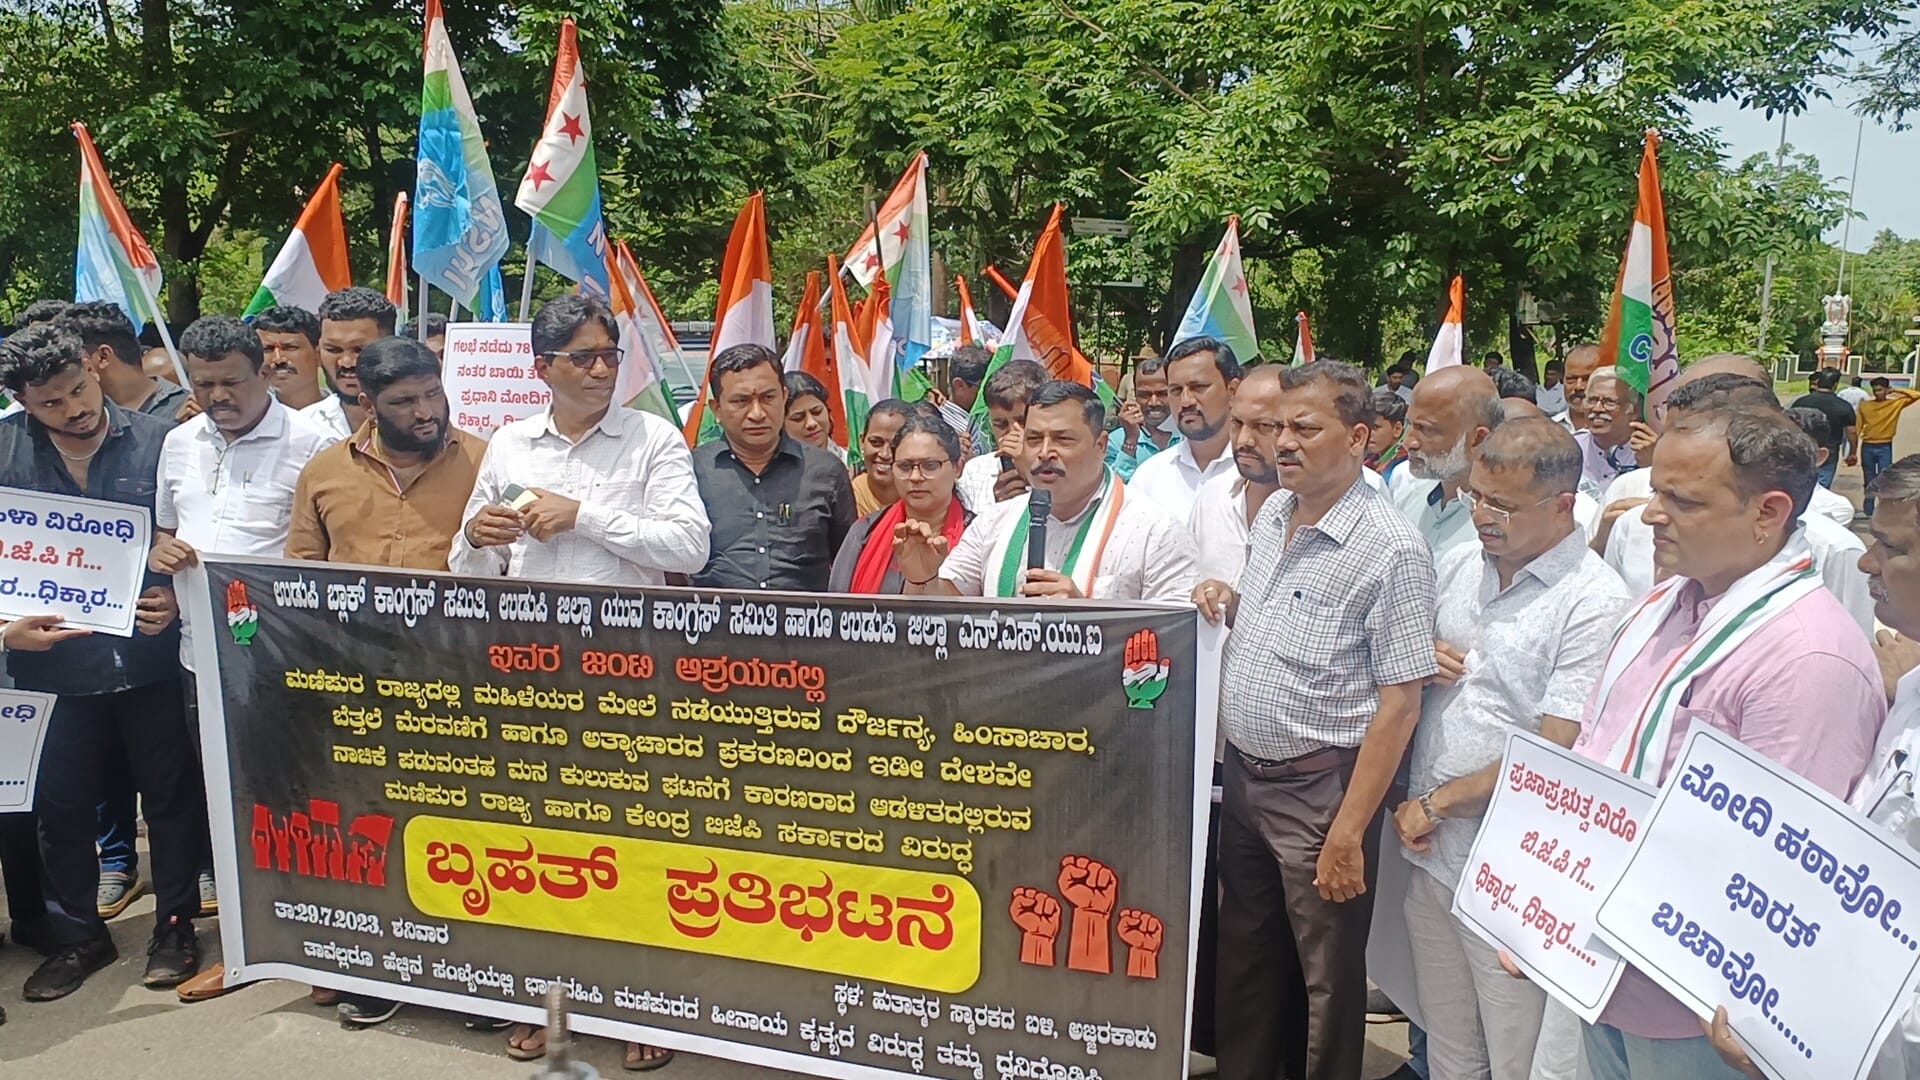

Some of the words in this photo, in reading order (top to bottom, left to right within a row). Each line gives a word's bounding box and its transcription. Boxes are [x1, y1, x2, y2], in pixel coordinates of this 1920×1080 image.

[453, 338, 477, 355] ಗಲಭೆ
[479, 339, 513, 354] ನಡೆದು
[516, 343, 531, 353] 78
[457, 364, 487, 377] ನಂತರ
[489, 367, 524, 379] ಬಾಯಿ
[461, 389, 497, 405] ಪ್ರಧಾನಿ
[500, 389, 551, 405] ಮೋದಿಗೆ
[45, 511, 135, 543] ವಿರೋಧಿ
[273, 572, 319, 609] ಉಡುಪಿ
[327, 576, 366, 623] ಬ್ಲಾಕ್
[374, 578, 436, 628] ಕಾಂಗ್ರೆಸ್
[444, 580, 489, 622] ಸಮಿತಿ,
[499, 583, 548, 623] ಉಡುಪಿ
[557, 593, 592, 638] ಜಿಲ್ಲಾ
[601, 591, 644, 628] ಯುವ
[653, 594, 720, 645] ಕಾಂಗ್ರೆಸ್
[729, 596, 777, 636] ಸಮಿತಿ
[785, 600, 833, 639] ಹಾಗೂ
[840, 603, 896, 643] ಉಡುಪಿ
[908, 611, 948, 660] ಜಿಲ್ಲಾ
[488, 642, 560, 673] ಇವರ
[582, 650, 654, 679] ಜಂಟಿ
[675, 653, 826, 703] ಆಶ್ರಯದಲ್ಲಿ
[285, 668, 364, 694] ಮಣಿಪುರ
[376, 678, 461, 710] ರಾಜ್ಯದಲ್ಲಿ
[474, 682, 584, 711] ಮಹಿಳೆಯರ
[598, 690, 657, 717] ಮೇಲೆ
[671, 697, 821, 735] ನಡೆಯುತ್ತಿರುವ
[953, 721, 1096, 756] ಹಿಂಸಾಚಾರ,
[333, 705, 382, 735] ಬೆತ್ತಲೆ
[395, 710, 488, 740] ಮೆರವಣಿಗೆ
[502, 722, 568, 747] ಹಾಗೂ
[582, 728, 704, 763] ಅತ್ಯಾಚಾರದ
[718, 738, 852, 773] ಪ್ರಕರಣದಿಂದ
[868, 754, 924, 779] ಇಡೀ
[940, 756, 1032, 788] ದೇಶವೇ
[333, 744, 387, 767] ನಾಚಿಕೆ
[398, 749, 496, 777] ಪಡುವಂತಹ
[508, 757, 548, 783] ಮನ
[560, 763, 649, 793] ಕುಲುಕುವ
[662, 772, 731, 801] ಘಟನೆಗೆ
[744, 783, 856, 814] ಕಾರಣರಾದ
[870, 795, 1032, 834] ಆಡಳಿತದಲ್ಲಿರುವ
[1510, 762, 1594, 833] ಪ್ರಜಾಪ್ರಭುತ್ವ
[1680, 764, 1773, 837] ಮೋದಿ
[384, 780, 468, 807] ಮಣಿಪುರ
[480, 791, 533, 824] ರಾಜ್ಯ
[544, 796, 612, 823] ಹಾಗೂ
[625, 802, 690, 838] ಕೇಂದ್ರ
[704, 812, 763, 840] ಬಿಜೆಪಿ
[777, 820, 884, 853] ಸರ್ಕಾರದ
[900, 834, 974, 874] ವಿರುದ್ಧ
[426, 834, 619, 916] ಬೃಹತ್
[666, 856, 955, 951] ಪ್ರತಿಭಟನೆ
[1725, 873, 1821, 949] ಭಾರತ್
[391, 918, 449, 945] ಶನಿವಾರ
[303, 940, 373, 969] ತಾವೆಲ್ಲರೂ
[383, 952, 423, 982] ಹೆಚ್ಚಿನ
[432, 958, 514, 996] ಸಂಖ್ಯೆಯಲ್ಲಿ
[614, 986, 699, 1020] ಮಣಿಪುರದ
[711, 1005, 788, 1036] ಹೀನಾಯ
[800, 1017, 855, 1056] ಕೃತ್ಯದ
[867, 1032, 924, 1073] ವಿರುದ್ಧ
[937, 1040, 984, 1080] ತಮ್ಮ
[872, 987, 940, 1027] ಹುತಾತ್ಮರ
[950, 1002, 1015, 1036] ಸ್ಮಾರಕದ
[1068, 1020, 1157, 1055] ಅಜ್ಜರಕಾಡು
